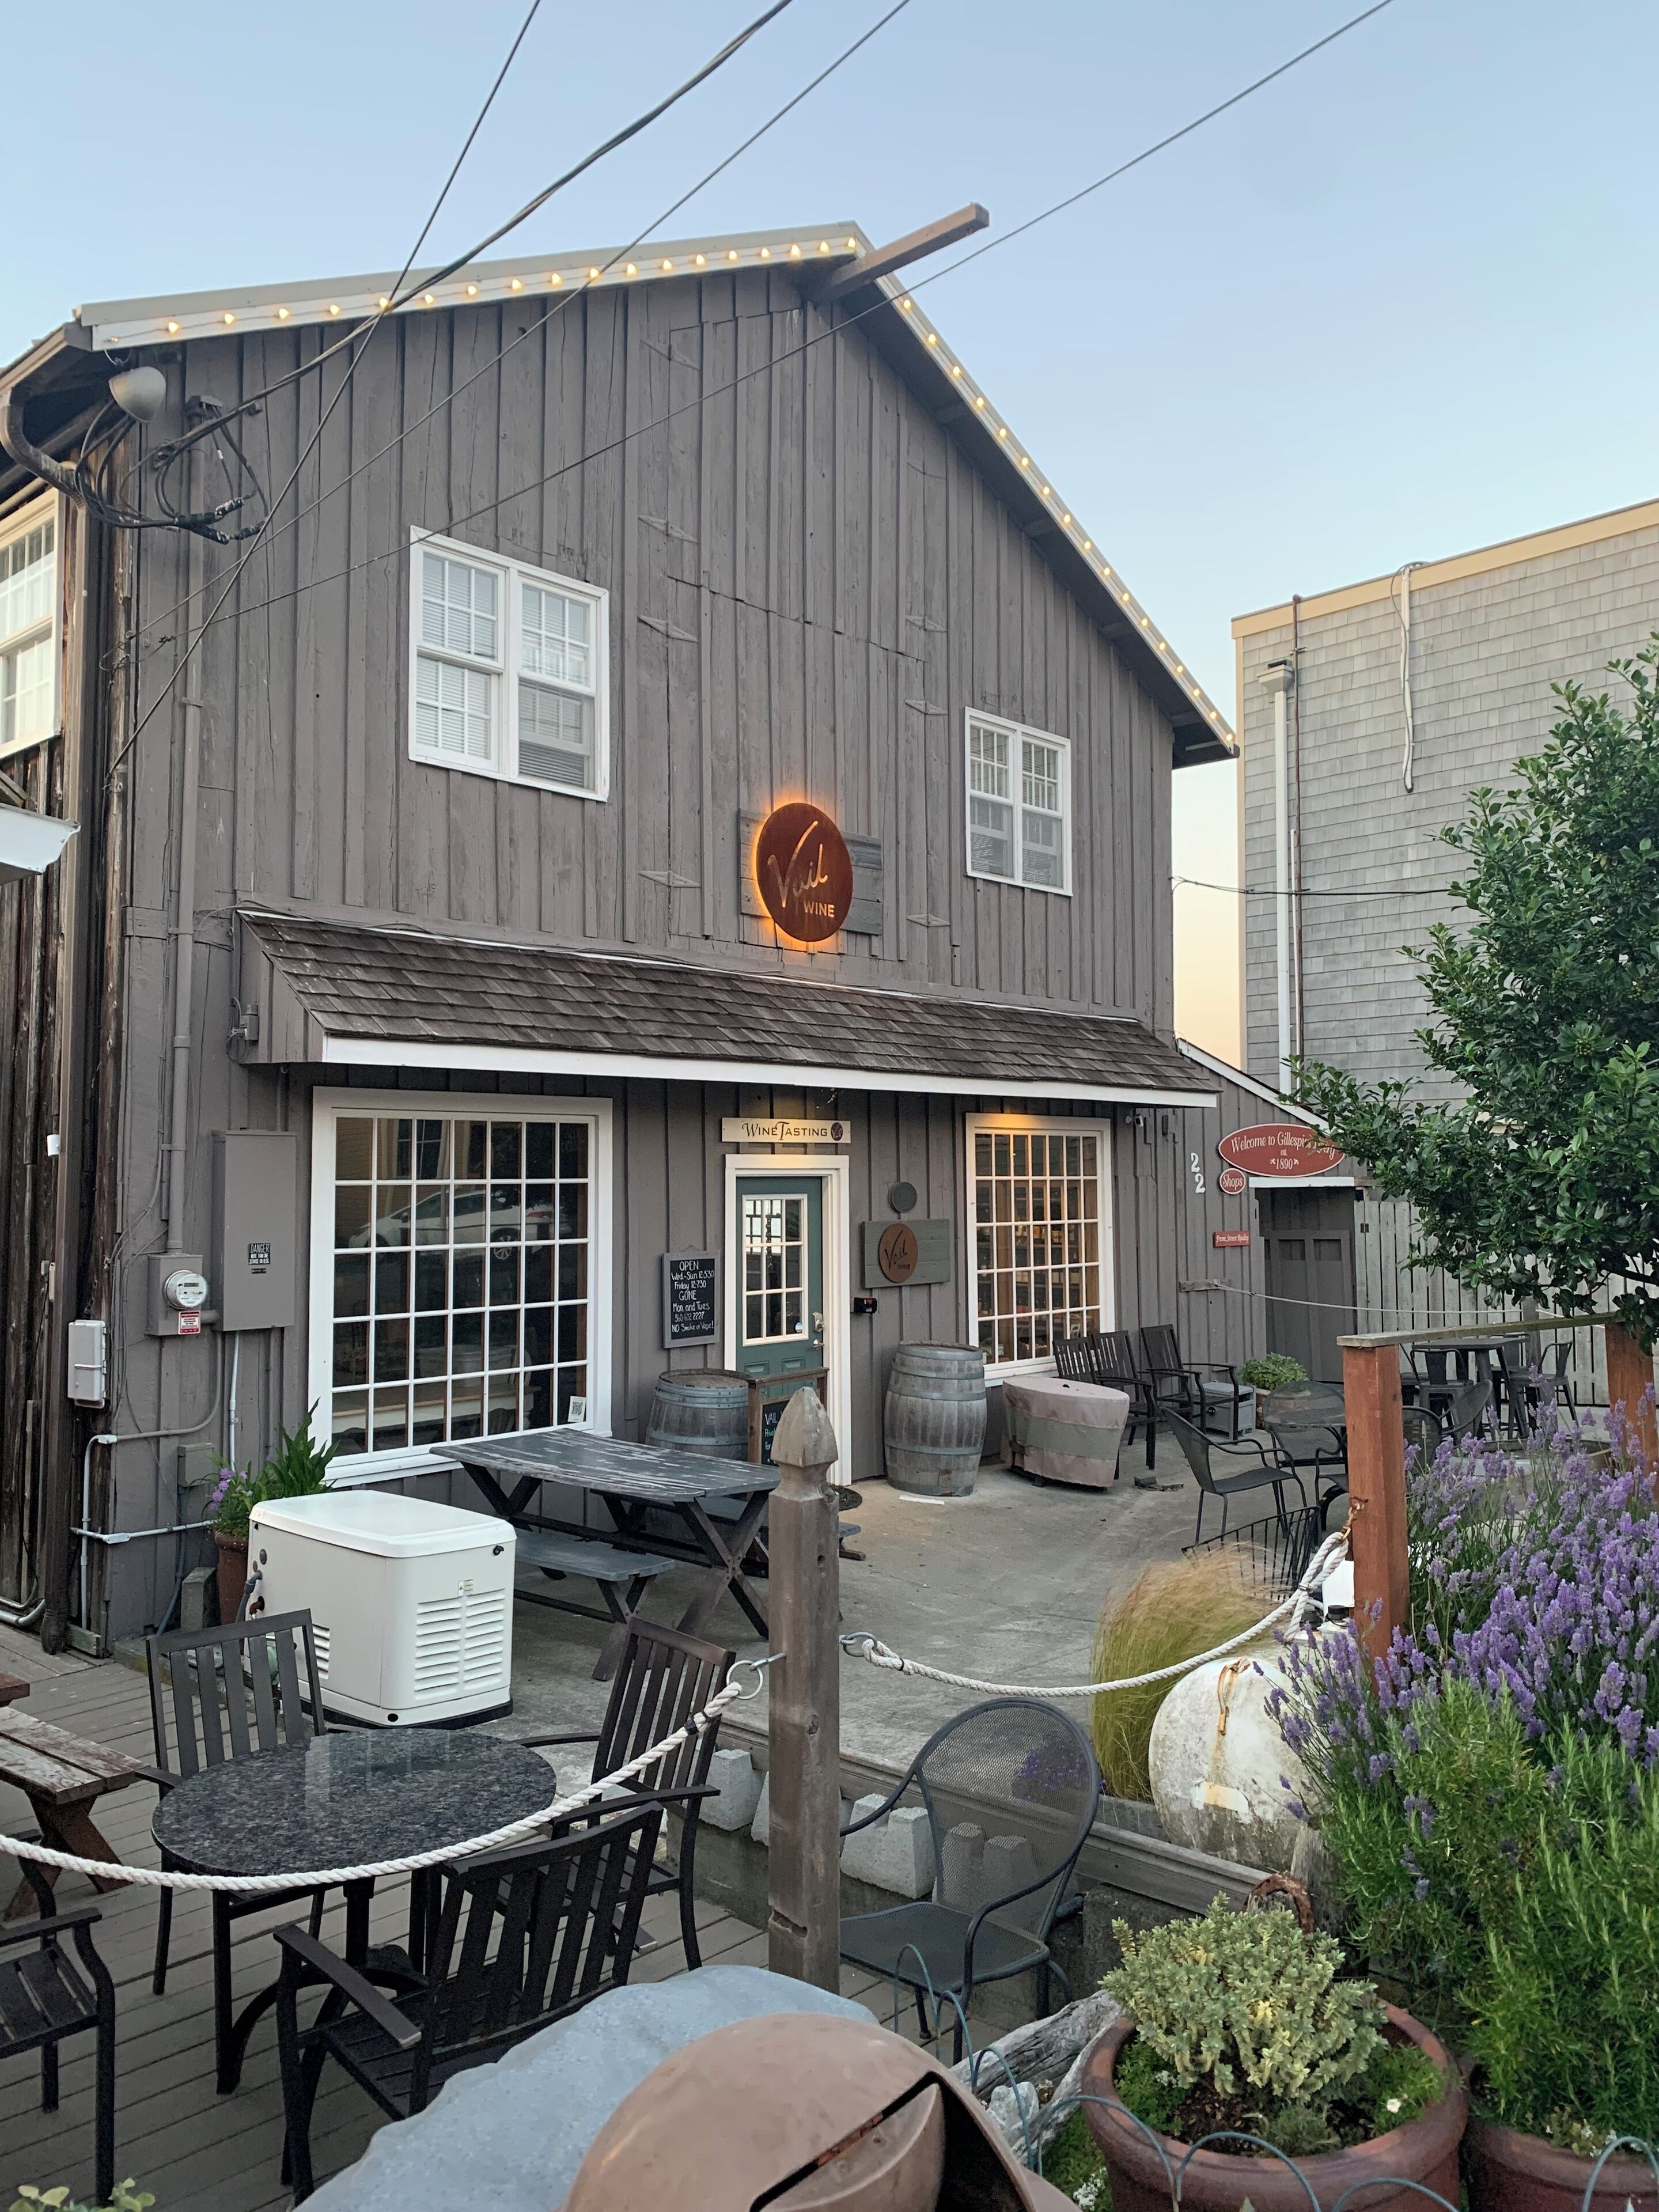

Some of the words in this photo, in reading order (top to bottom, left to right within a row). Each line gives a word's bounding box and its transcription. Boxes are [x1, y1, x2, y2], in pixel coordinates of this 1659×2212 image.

[767, 821, 828, 908] Vail
[803, 900, 835, 918] WINE
[1231, 1135, 1266, 1153] Welcome
[1268, 1135, 1275, 1146] to
[1275, 1158, 1293, 1169] 1890
[1222, 1173, 1243, 1191] Shops
[250, 1244, 270, 1253] DANGER
[679, 1260, 699, 1271] OPEN
[674, 1281, 690, 1291] Friday
[679, 1290, 697, 1301] GONE
[673, 1302, 684, 1312] Mon
[685, 1301, 696, 1311] and
[695, 1301, 710, 1310] Tues
[672, 1324, 680, 1332] NO
[680, 1323, 695, 1332] Smoke
